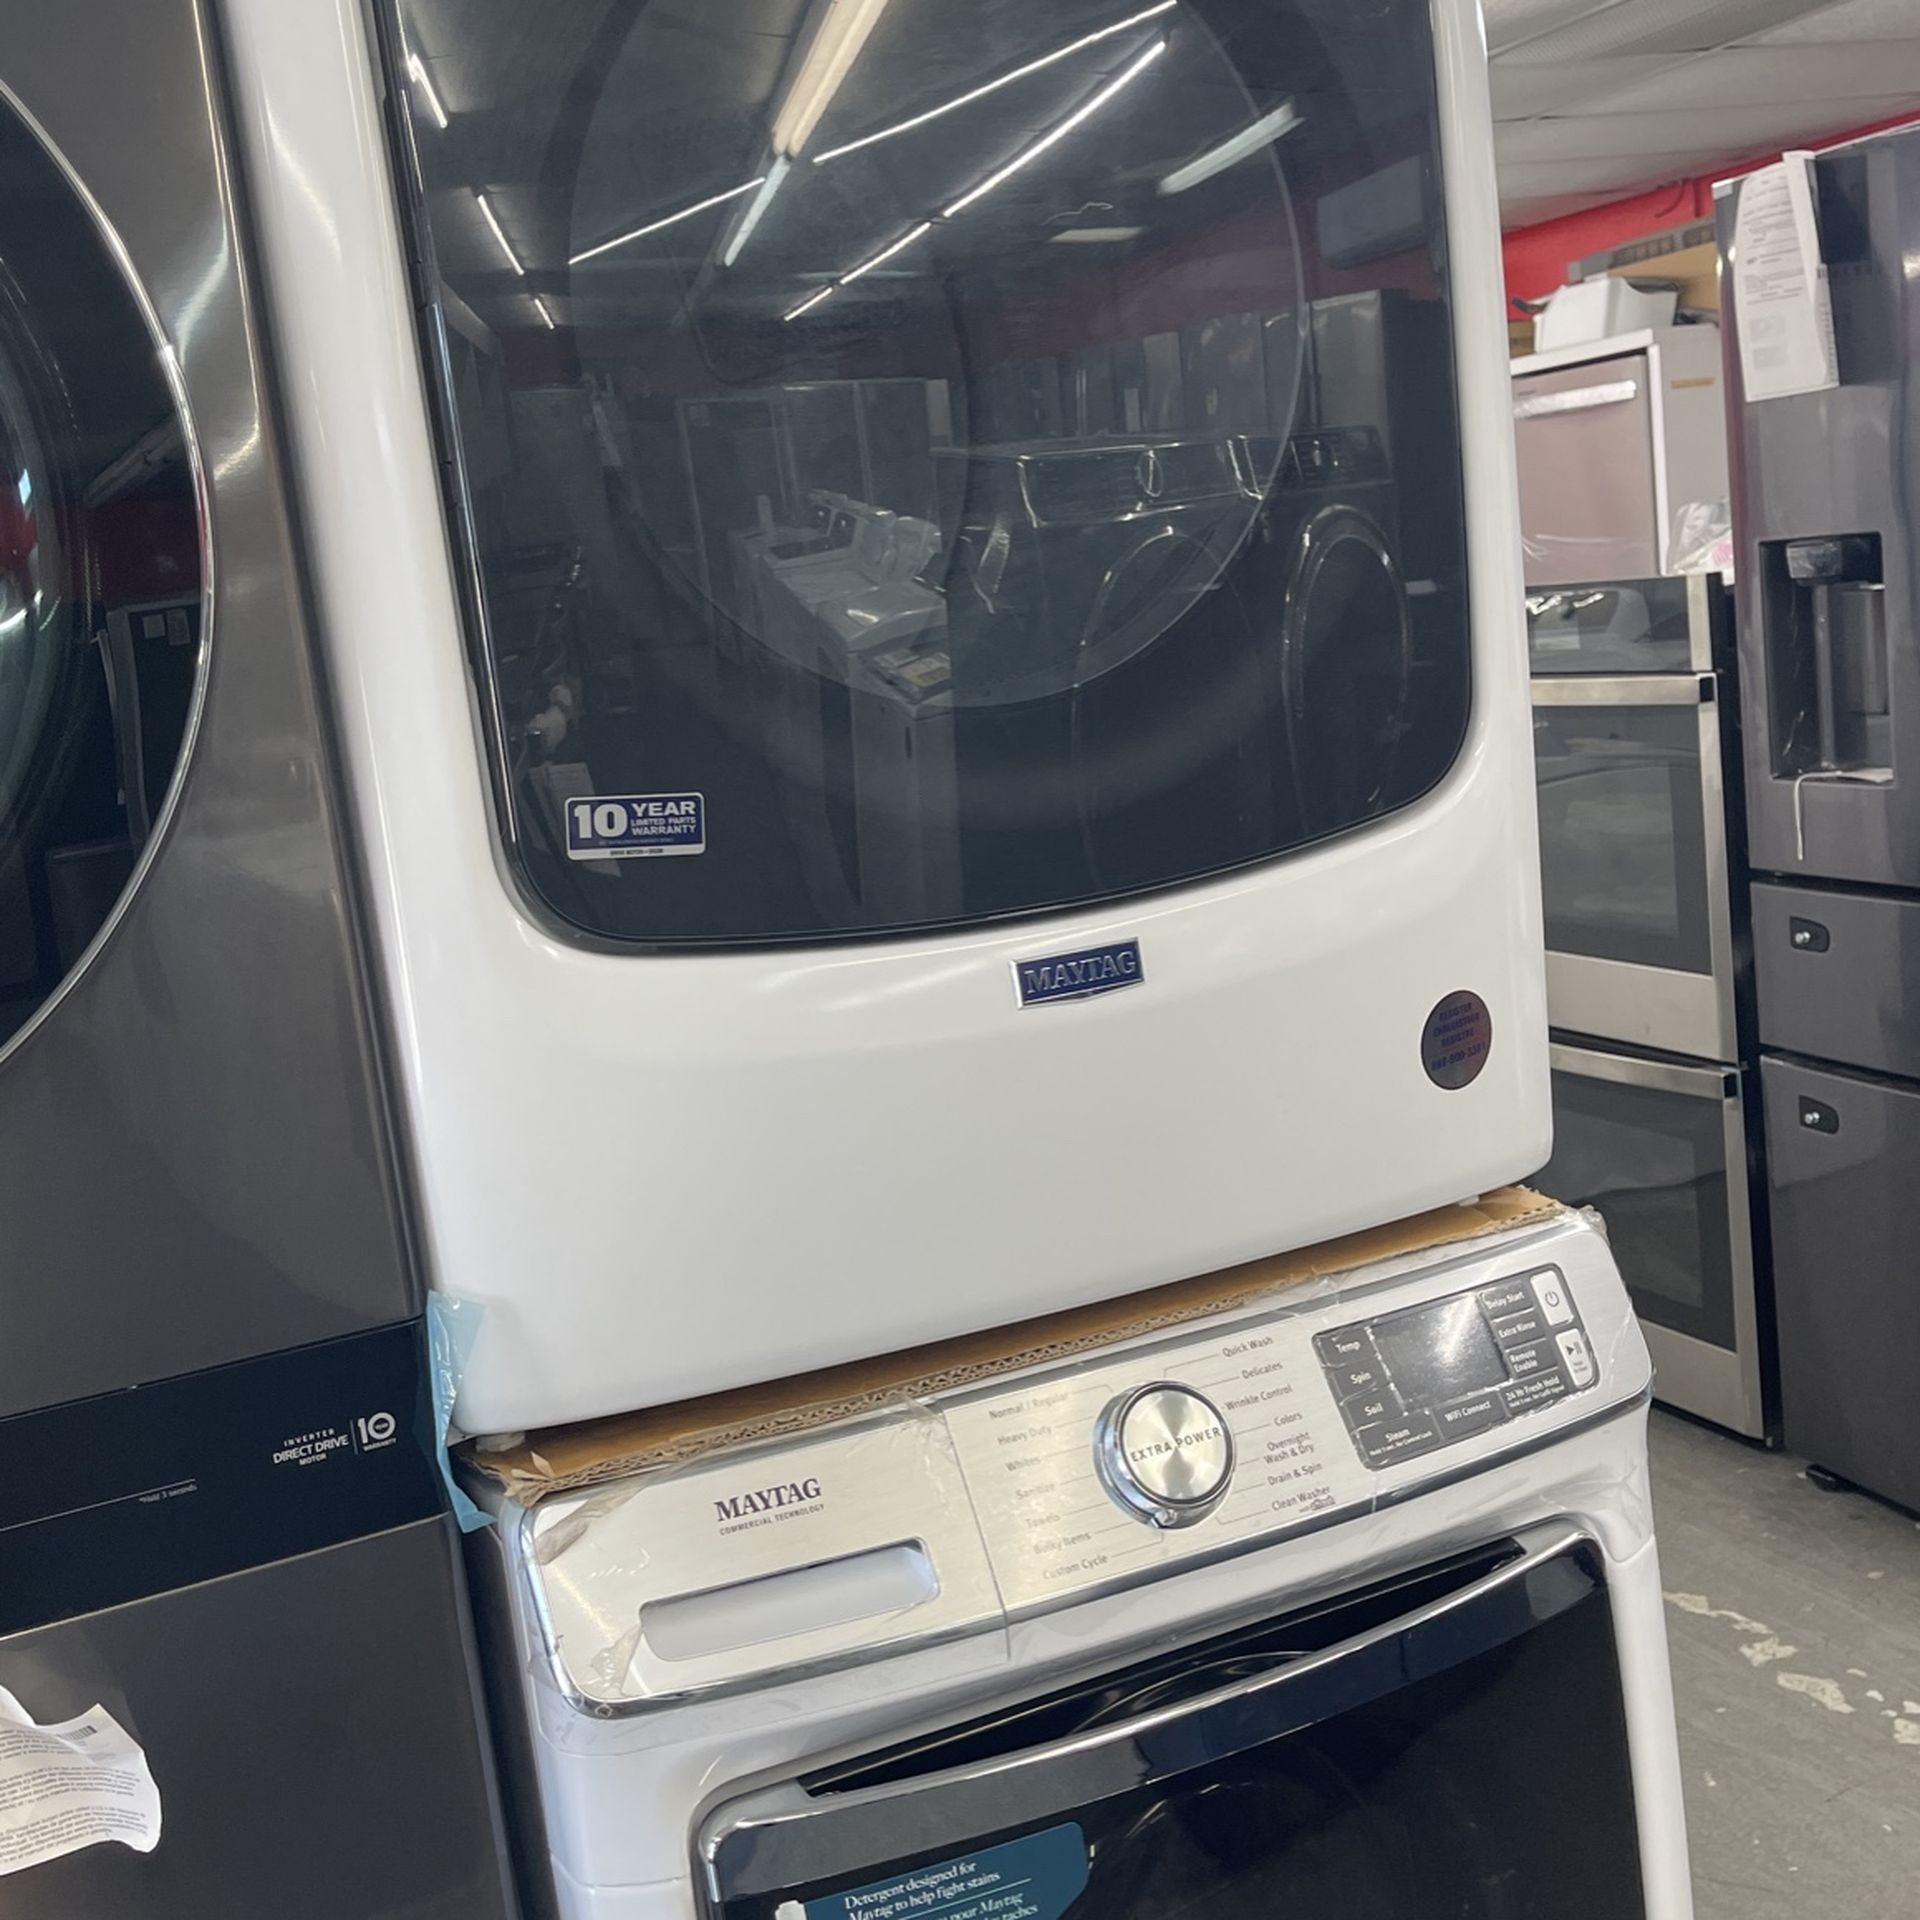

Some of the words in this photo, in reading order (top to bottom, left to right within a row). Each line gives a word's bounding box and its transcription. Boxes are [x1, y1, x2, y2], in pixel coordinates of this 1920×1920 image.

[631, 801, 696, 817] YEAR
[574, 803, 628, 839] 10
[630, 818, 665, 827] LIMITED
[668, 816, 697, 825] PARTS
[631, 825, 697, 836] WARRANTY
[1024, 950, 1136, 994] MAYTAG
[1507, 1291, 1525, 1303] Start
[1499, 1326, 1517, 1338] Extra
[1517, 1321, 1536, 1332] Rinse
[1222, 1343, 1248, 1358] Quick
[1248, 1336, 1273, 1351] Wash
[1336, 1341, 1361, 1354] Temp
[1510, 1350, 1536, 1363] Remote
[1241, 1361, 1283, 1379] Delicates
[1514, 1359, 1538, 1373] Enable
[1350, 1372, 1372, 1384] Spin
[1505, 1391, 1516, 1401] 24
[1524, 1381, 1544, 1395] Fresh
[1543, 1375, 1560, 1387] Hold
[989, 1401, 1024, 1419] Normal
[1033, 1391, 1069, 1412] Regular
[1225, 1393, 1259, 1411] Wrinkle
[1260, 1384, 1292, 1402] Control
[1274, 1411, 1303, 1427] Colors
[1364, 1402, 1384, 1416] Soil
[1444, 1409, 1462, 1422] WiFi
[1462, 1400, 1492, 1417] Connect
[284, 1428, 335, 1447] INVERTER
[358, 1412, 396, 1444] 10
[998, 1429, 1027, 1446] Heavy
[1030, 1425, 1053, 1439] Duty
[1385, 1429, 1410, 1442] Steam
[272, 1444, 313, 1464] DIRECT
[315, 1434, 349, 1453] DRIVE
[1129, 1441, 1172, 1462] EXTRA
[1175, 1427, 1222, 1449] POWER
[1267, 1431, 1310, 1451] Overnight
[299, 1453, 327, 1465] MOTOR
[1005, 1455, 1042, 1471] Whites
[1264, 1450, 1289, 1464] Wash
[1291, 1448, 1298, 1457] &
[1300, 1443, 1315, 1457] Dry
[1267, 1472, 1292, 1486] Drain
[1293, 1469, 1301, 1478] &
[1301, 1462, 1323, 1478] Spin
[713, 1478, 822, 1522] MAYTAG
[1272, 1495, 1298, 1511] Clean
[1299, 1486, 1331, 1503] Washer
[720, 1516, 772, 1536] COMMERCIAL
[774, 1503, 825, 1522] TECHNOLOGY
[1025, 1513, 1061, 1529] Towels
[1034, 1537, 1062, 1555] Bulky
[1064, 1530, 1092, 1546] Items
[1043, 1562, 1080, 1581] Custom
[1081, 1553, 1109, 1572] Cycle
[845, 1884, 906, 1909] Detergent
[906, 1866, 958, 1892] designed
[958, 1861, 977, 1876] for
[849, 1905, 894, 1920] Maytag
[895, 1899, 909, 1911] to
[909, 1891, 936, 1906] help
[936, 1881, 966, 1900] fight
[966, 1872, 1001, 1890] stains
[949, 1907, 978, 1920] pour
[980, 1893, 1024, 1915] Maytag
